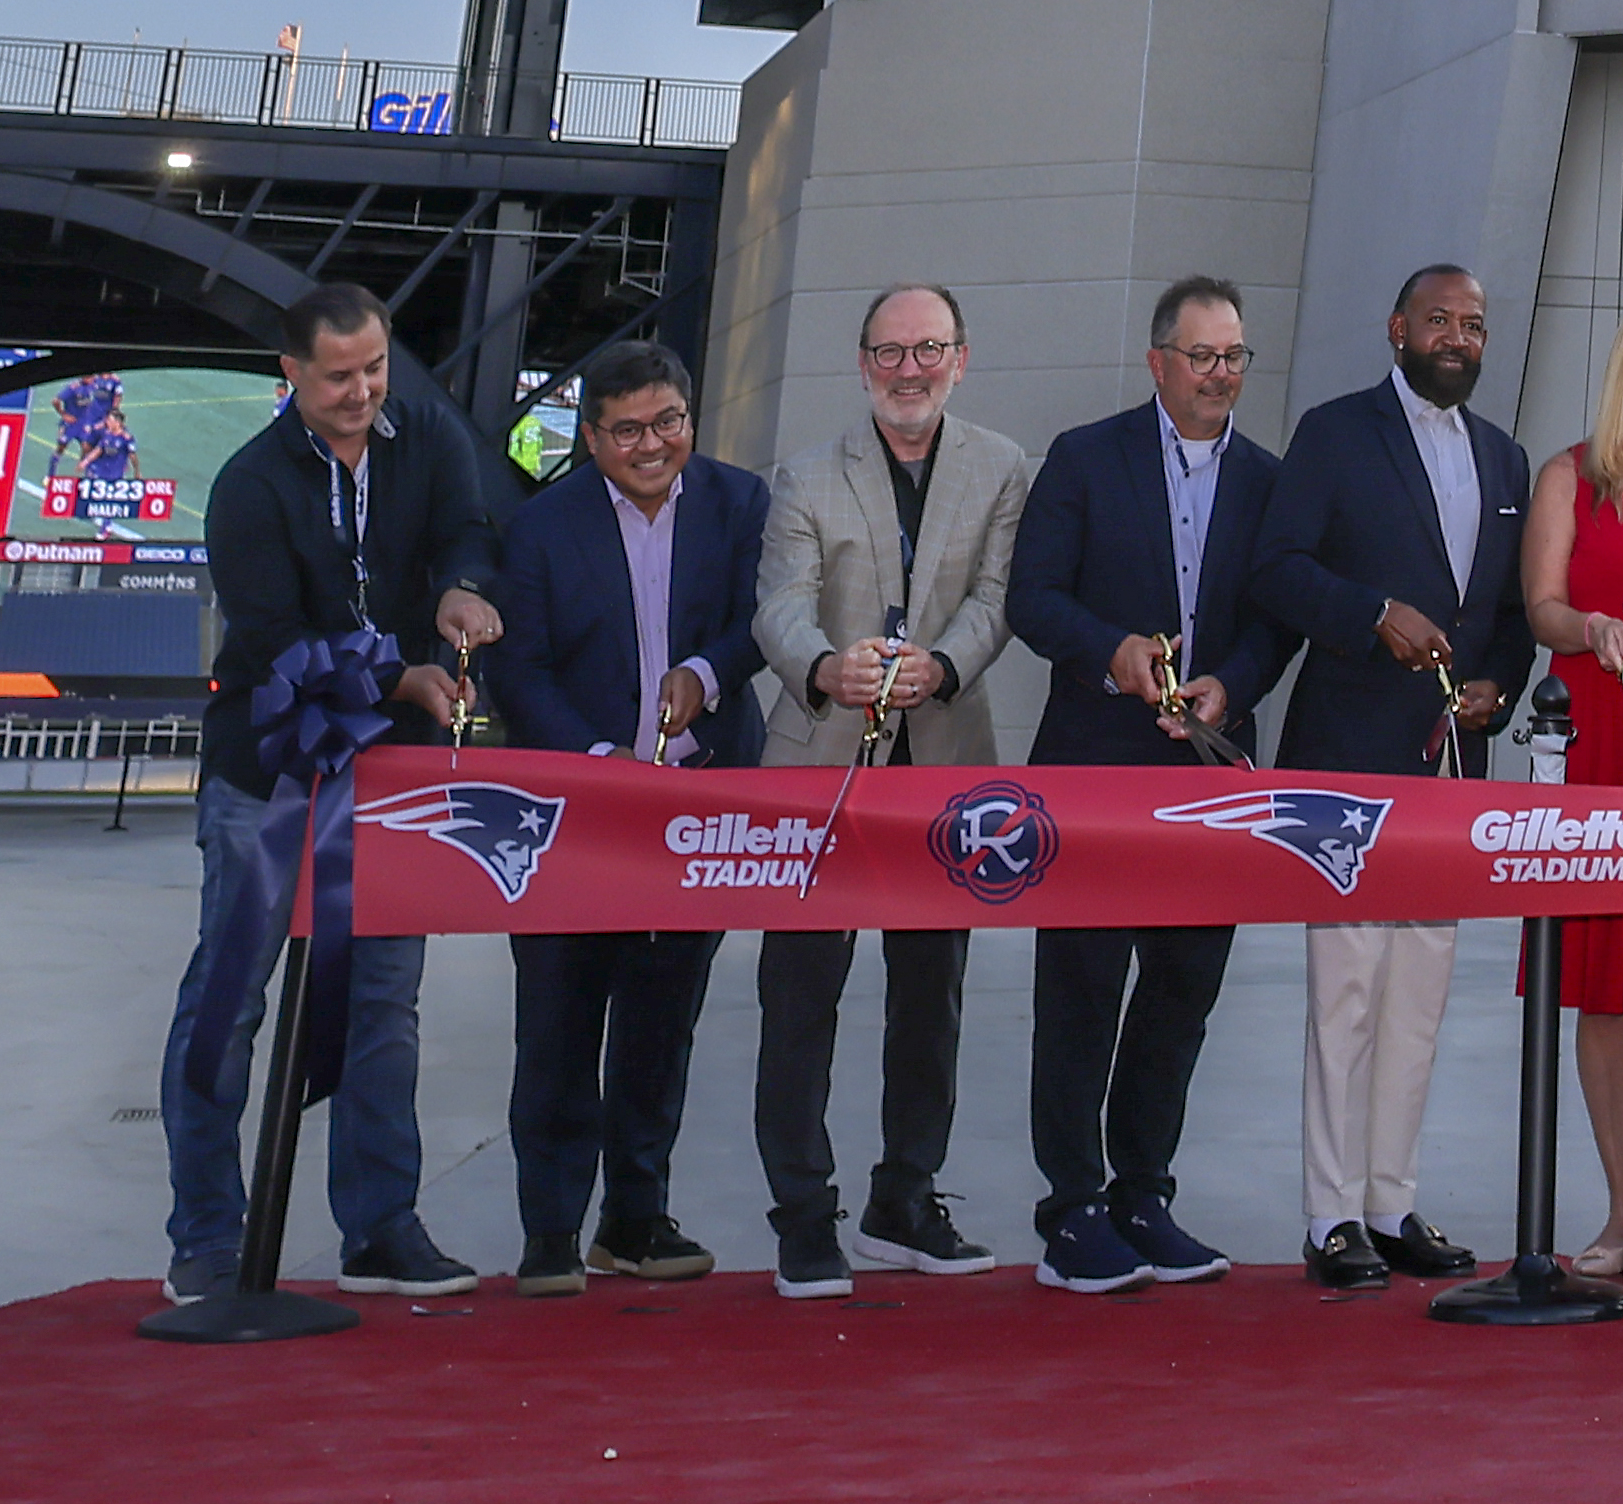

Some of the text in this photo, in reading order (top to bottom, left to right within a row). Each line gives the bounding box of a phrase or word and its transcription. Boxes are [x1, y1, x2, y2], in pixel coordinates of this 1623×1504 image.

[52, 479, 174, 501] NE 13:23 ORL
[52, 496, 166, 515] 0 0
[25, 542, 104, 563] Putnam
[664, 814, 837, 856] Gillette
